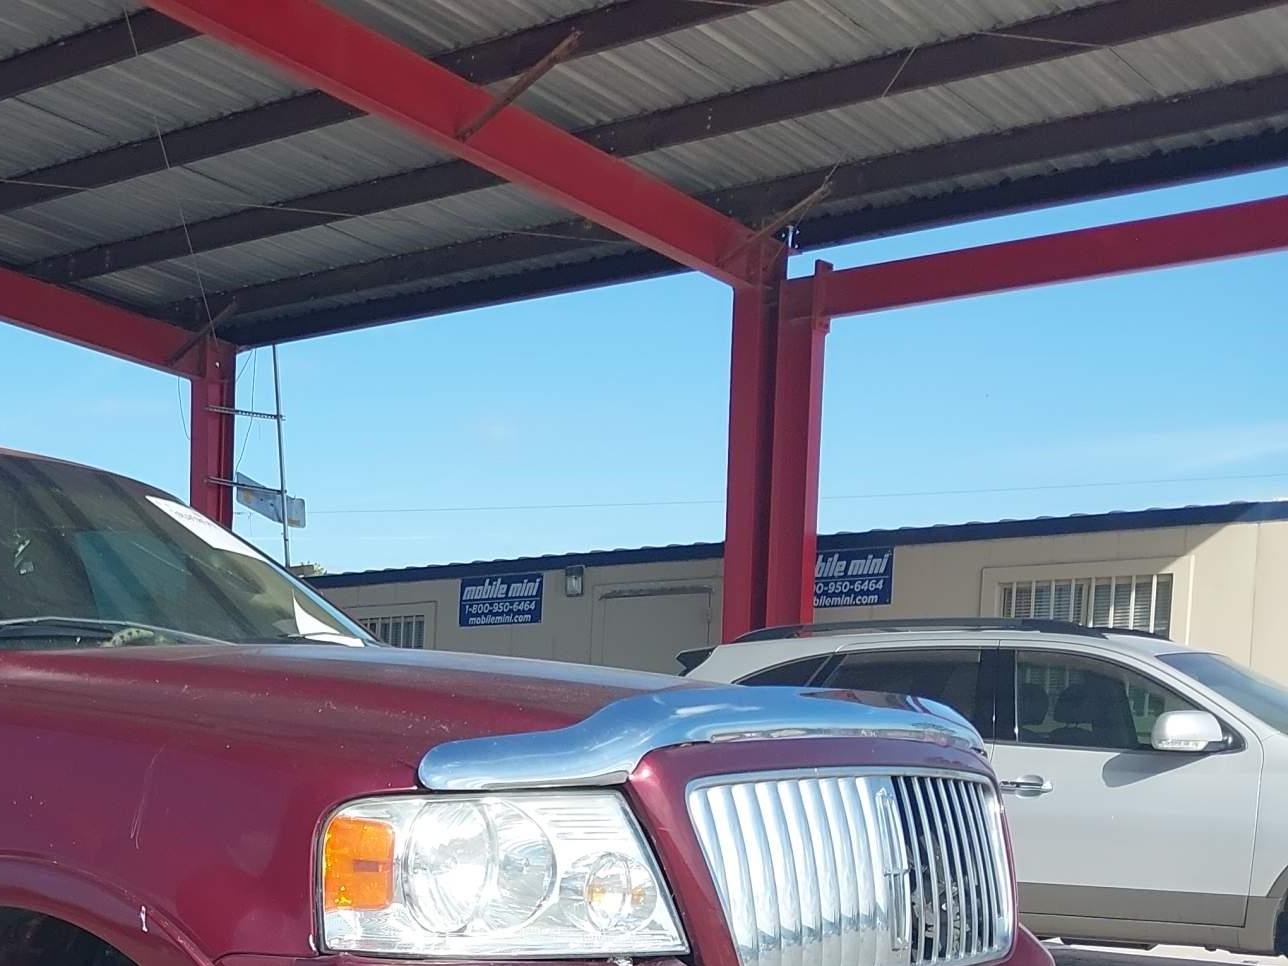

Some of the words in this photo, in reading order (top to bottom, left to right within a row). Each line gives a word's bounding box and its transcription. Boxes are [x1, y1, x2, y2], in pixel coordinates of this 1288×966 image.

[814, 553, 847, 577] bile
[847, 553, 890, 576] mini
[462, 578, 508, 600] mobile
[508, 578, 541, 597] mini
[814, 580, 884, 594] 0-950-6464
[813, 594, 879, 606] bilemini.com
[465, 600, 536, 615] 1-800-950-6464
[468, 613, 532, 625] mobilemini.com
